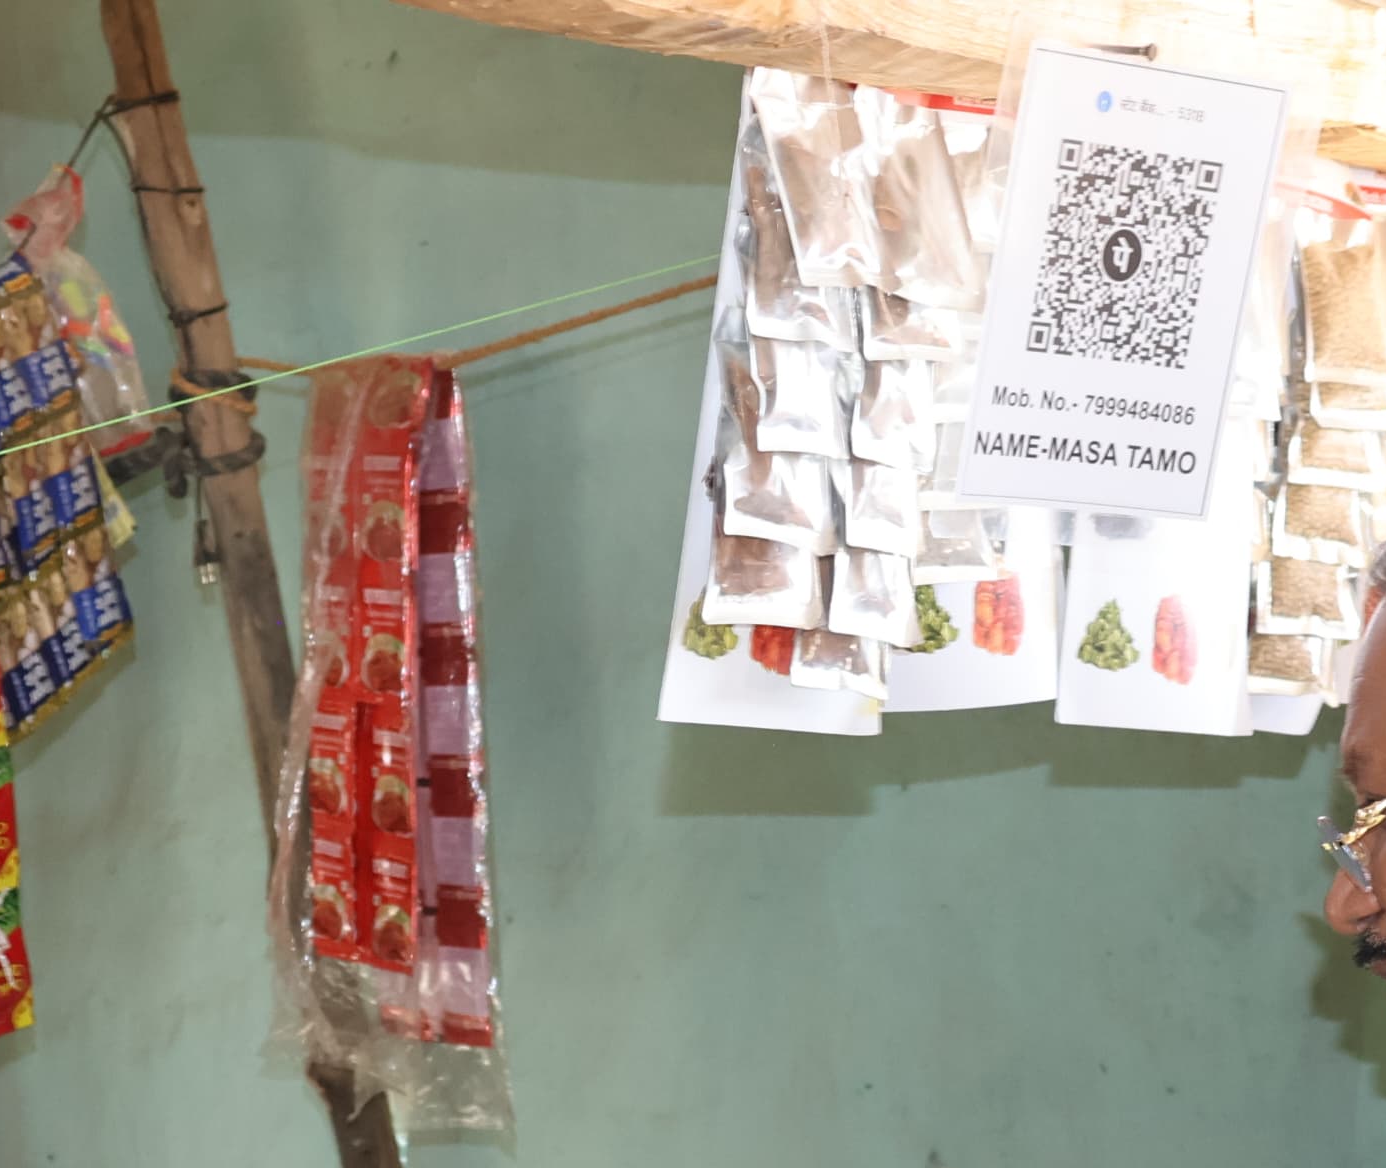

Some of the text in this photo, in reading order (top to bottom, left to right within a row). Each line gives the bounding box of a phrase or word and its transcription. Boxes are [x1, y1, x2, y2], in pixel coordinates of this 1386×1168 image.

[991, 384, 1196, 427] Mob. No.- 7999484086
[972, 430, 1198, 477] NAME-MASA TAMO
